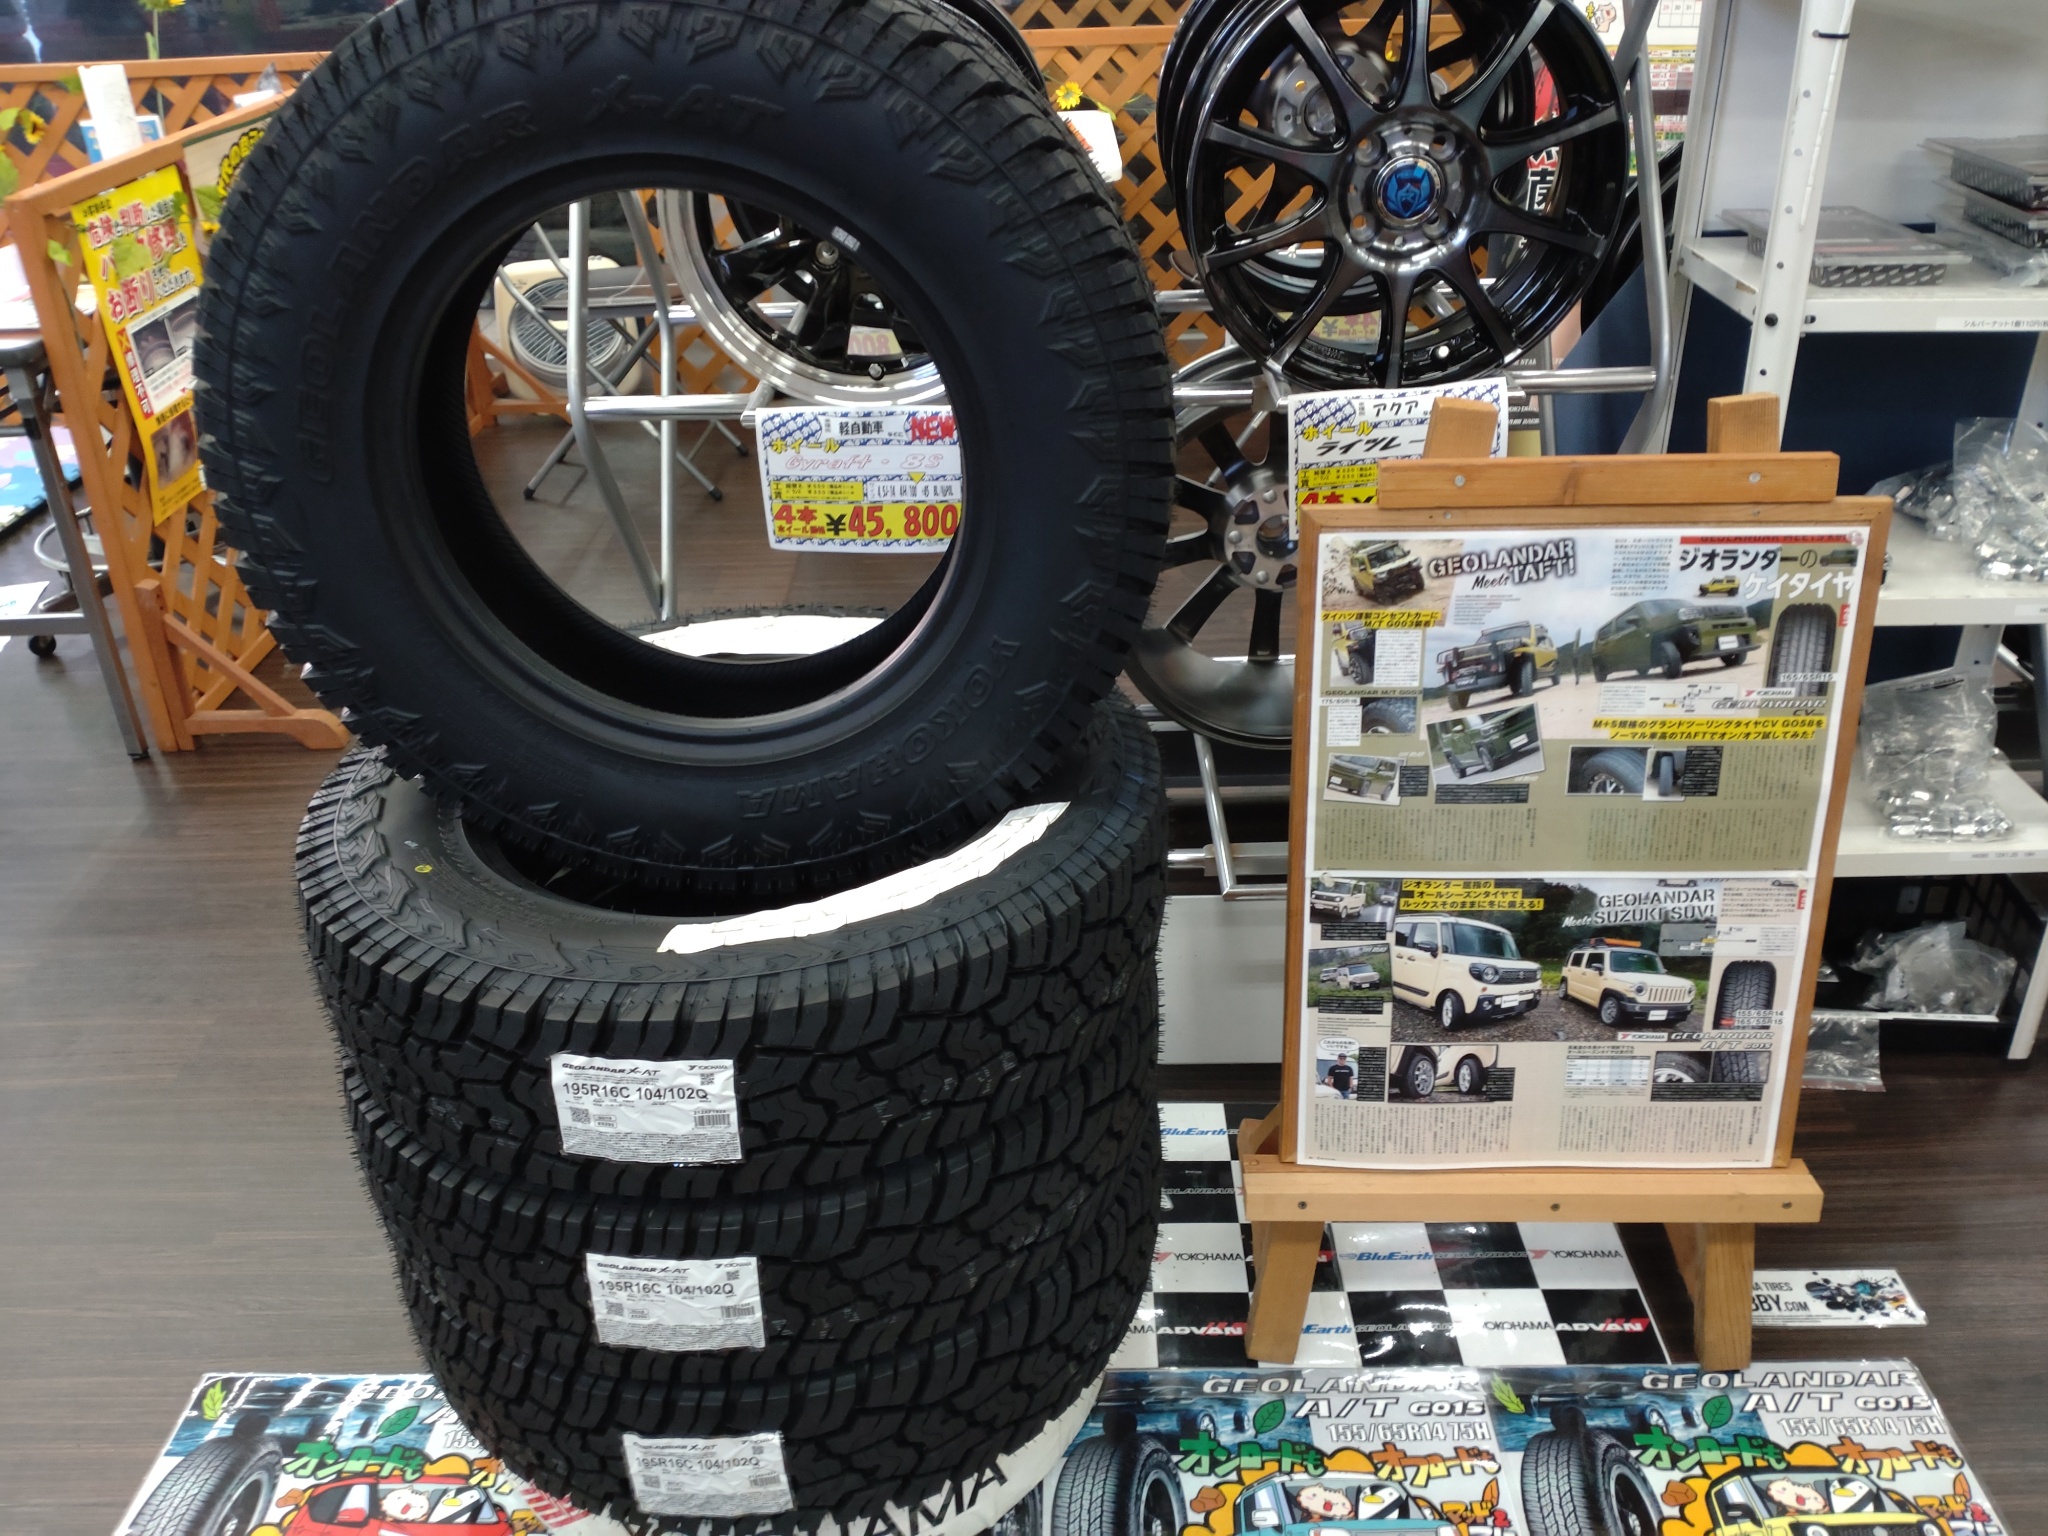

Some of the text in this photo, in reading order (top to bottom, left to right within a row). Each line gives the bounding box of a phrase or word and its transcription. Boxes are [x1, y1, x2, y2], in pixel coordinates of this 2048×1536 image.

[297, 98, 540, 484] GEOLANDAR
[1373, 400, 1419, 418] アクア
[838, 421, 884, 436] 軽自動車
[910, 415, 958, 442] NEW
[1302, 420, 1375, 441] ホイール
[771, 438, 842, 454] ホイール
[774, 504, 818, 525] 4本
[1428, 539, 1576, 578] GEOLANDAR
[1679, 547, 1819, 572] ジオランダーの
[1471, 557, 1576, 591] Meets TAFT!
[1744, 570, 1856, 601] ケイタイヤ
[738, 636, 1022, 820] YOKOHAMA
[1416, 890, 1520, 899] オールシーズンタイヤで
[1600, 888, 1716, 909] GEOLANDAR
[1562, 915, 1593, 928] Meets
[1594, 907, 1664, 926] SUZUKI
[1669, 904, 1716, 924] SUV!
[1736, 1018, 1784, 1026] 165/55R15
[1670, 1031, 1776, 1041] GEOLANDAR
[1701, 1040, 1741, 1050] A/T
[562, 1062, 626, 1075] GEOLANDAR
[562, 1082, 709, 1101] 195R16C 104/102Q
[1161, 1127, 1228, 1136] BluEarth
[1174, 1252, 1244, 1262] YOKOHAMA
[1356, 1251, 1435, 1261] BluEarth
[1551, 1250, 1624, 1259] YOKOHAMA
[598, 1279, 735, 1296] 195R16C 104/102Q
[1762, 1282, 1794, 1292] TIRES
[1157, 1325, 1244, 1335] ADVAN
[1555, 1322, 1643, 1332] ADVAN
[1641, 1369, 1920, 1390] GEOLANDAR
[1296, 1396, 1487, 1419] A/T G015
[1740, 1392, 1935, 1413] A/T G015
[1326, 1421, 1493, 1443] 155/65R14 75H
[1777, 1415, 1947, 1438] 155/65R14 75H
[1177, 1430, 1328, 1477] オンロードも
[1632, 1426, 1791, 1471] オンロードも
[634, 1456, 760, 1470] 195R16C 104/102Q
